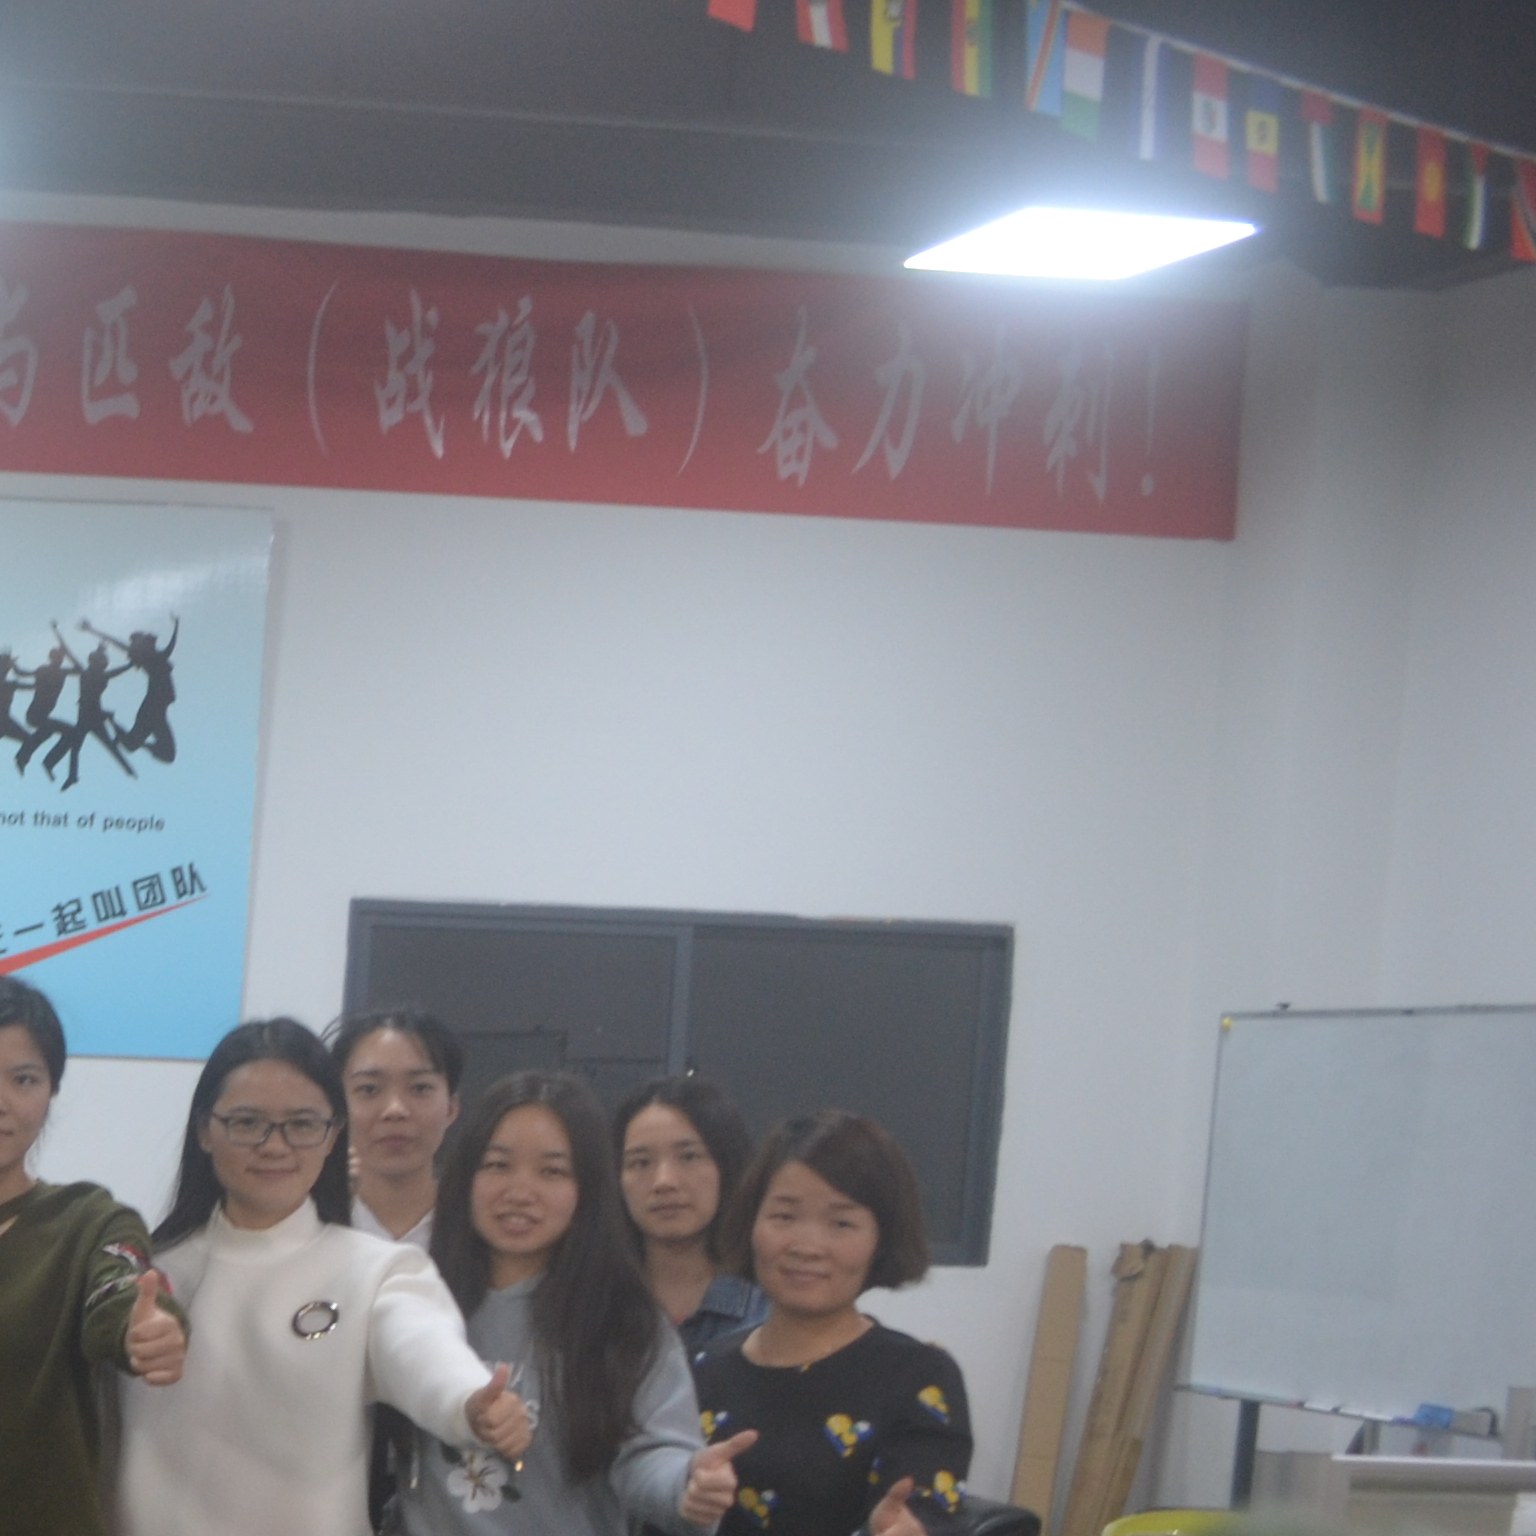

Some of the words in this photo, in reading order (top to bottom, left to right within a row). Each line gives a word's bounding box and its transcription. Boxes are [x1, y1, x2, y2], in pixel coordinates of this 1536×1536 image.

[33, 810, 69, 829] that
[77, 811, 96, 829] of
[102, 813, 165, 834] people
